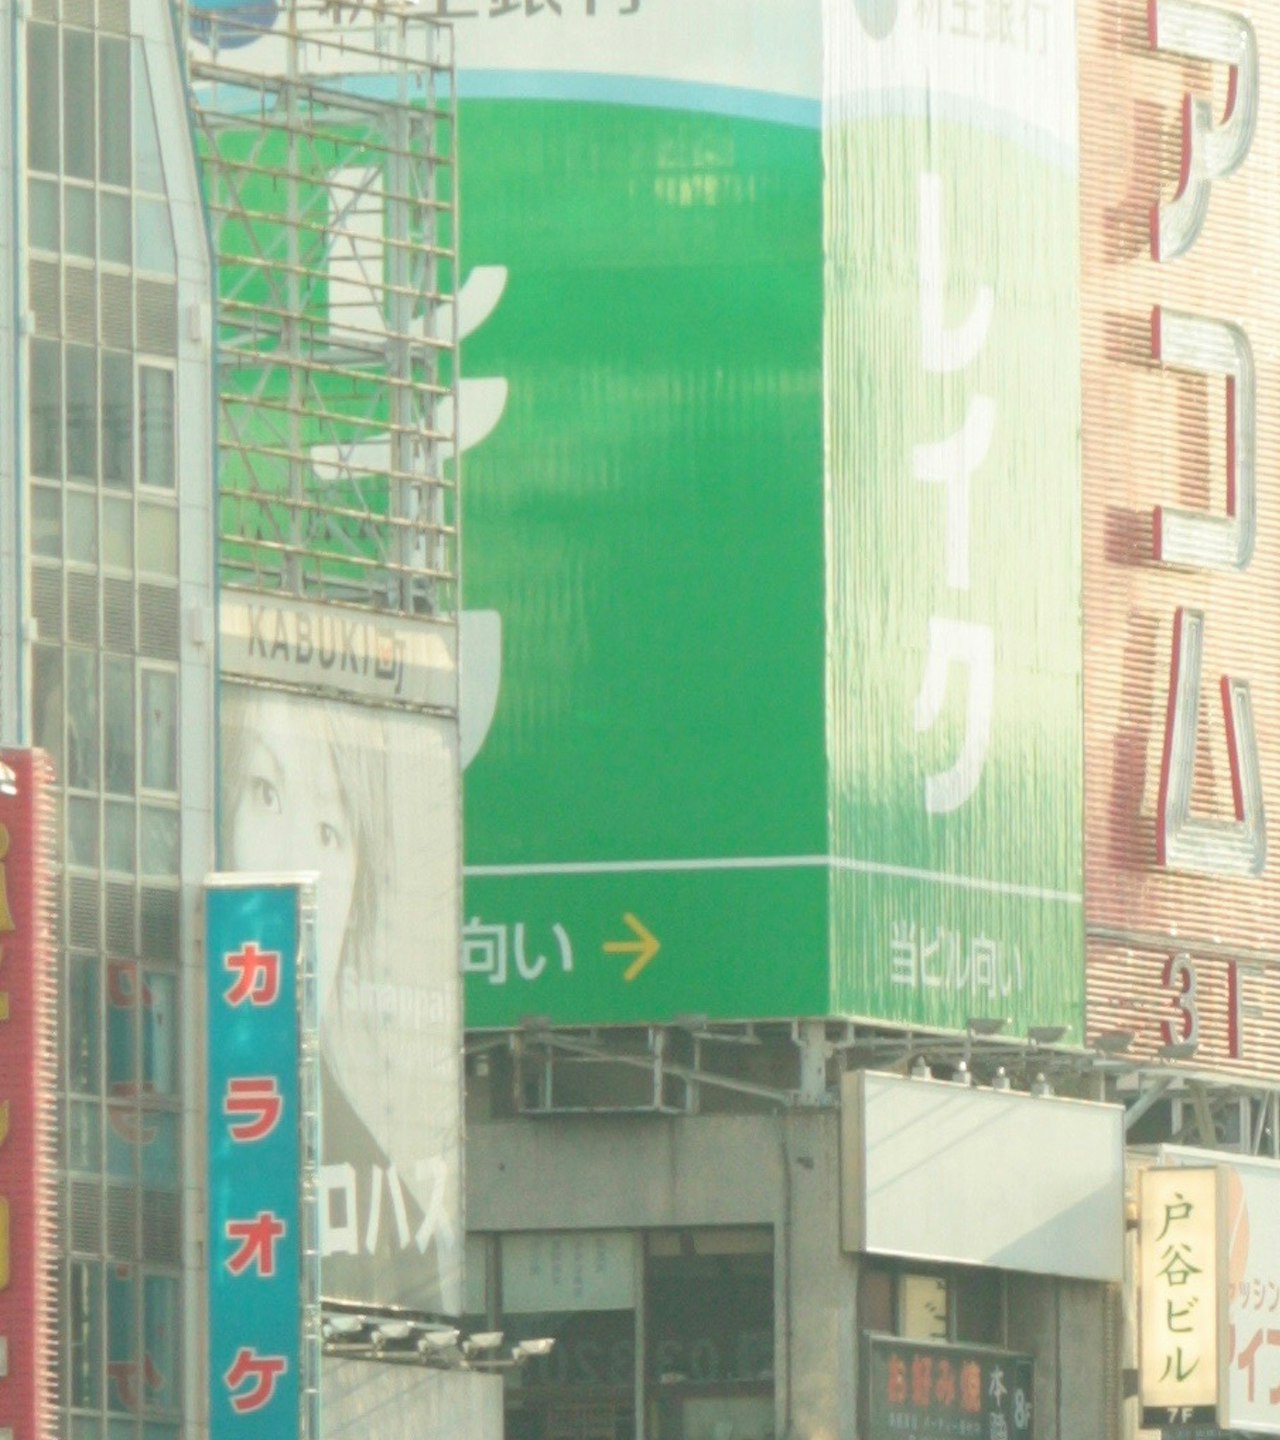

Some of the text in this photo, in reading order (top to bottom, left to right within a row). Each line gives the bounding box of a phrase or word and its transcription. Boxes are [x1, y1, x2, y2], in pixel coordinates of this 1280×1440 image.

[911, 171, 995, 816] レイク
[1160, 950, 1264, 1057] 3F
[1156, 1193, 1203, 1384] 戸谷ビル
[1166, 1407, 1194, 1424] 7F
